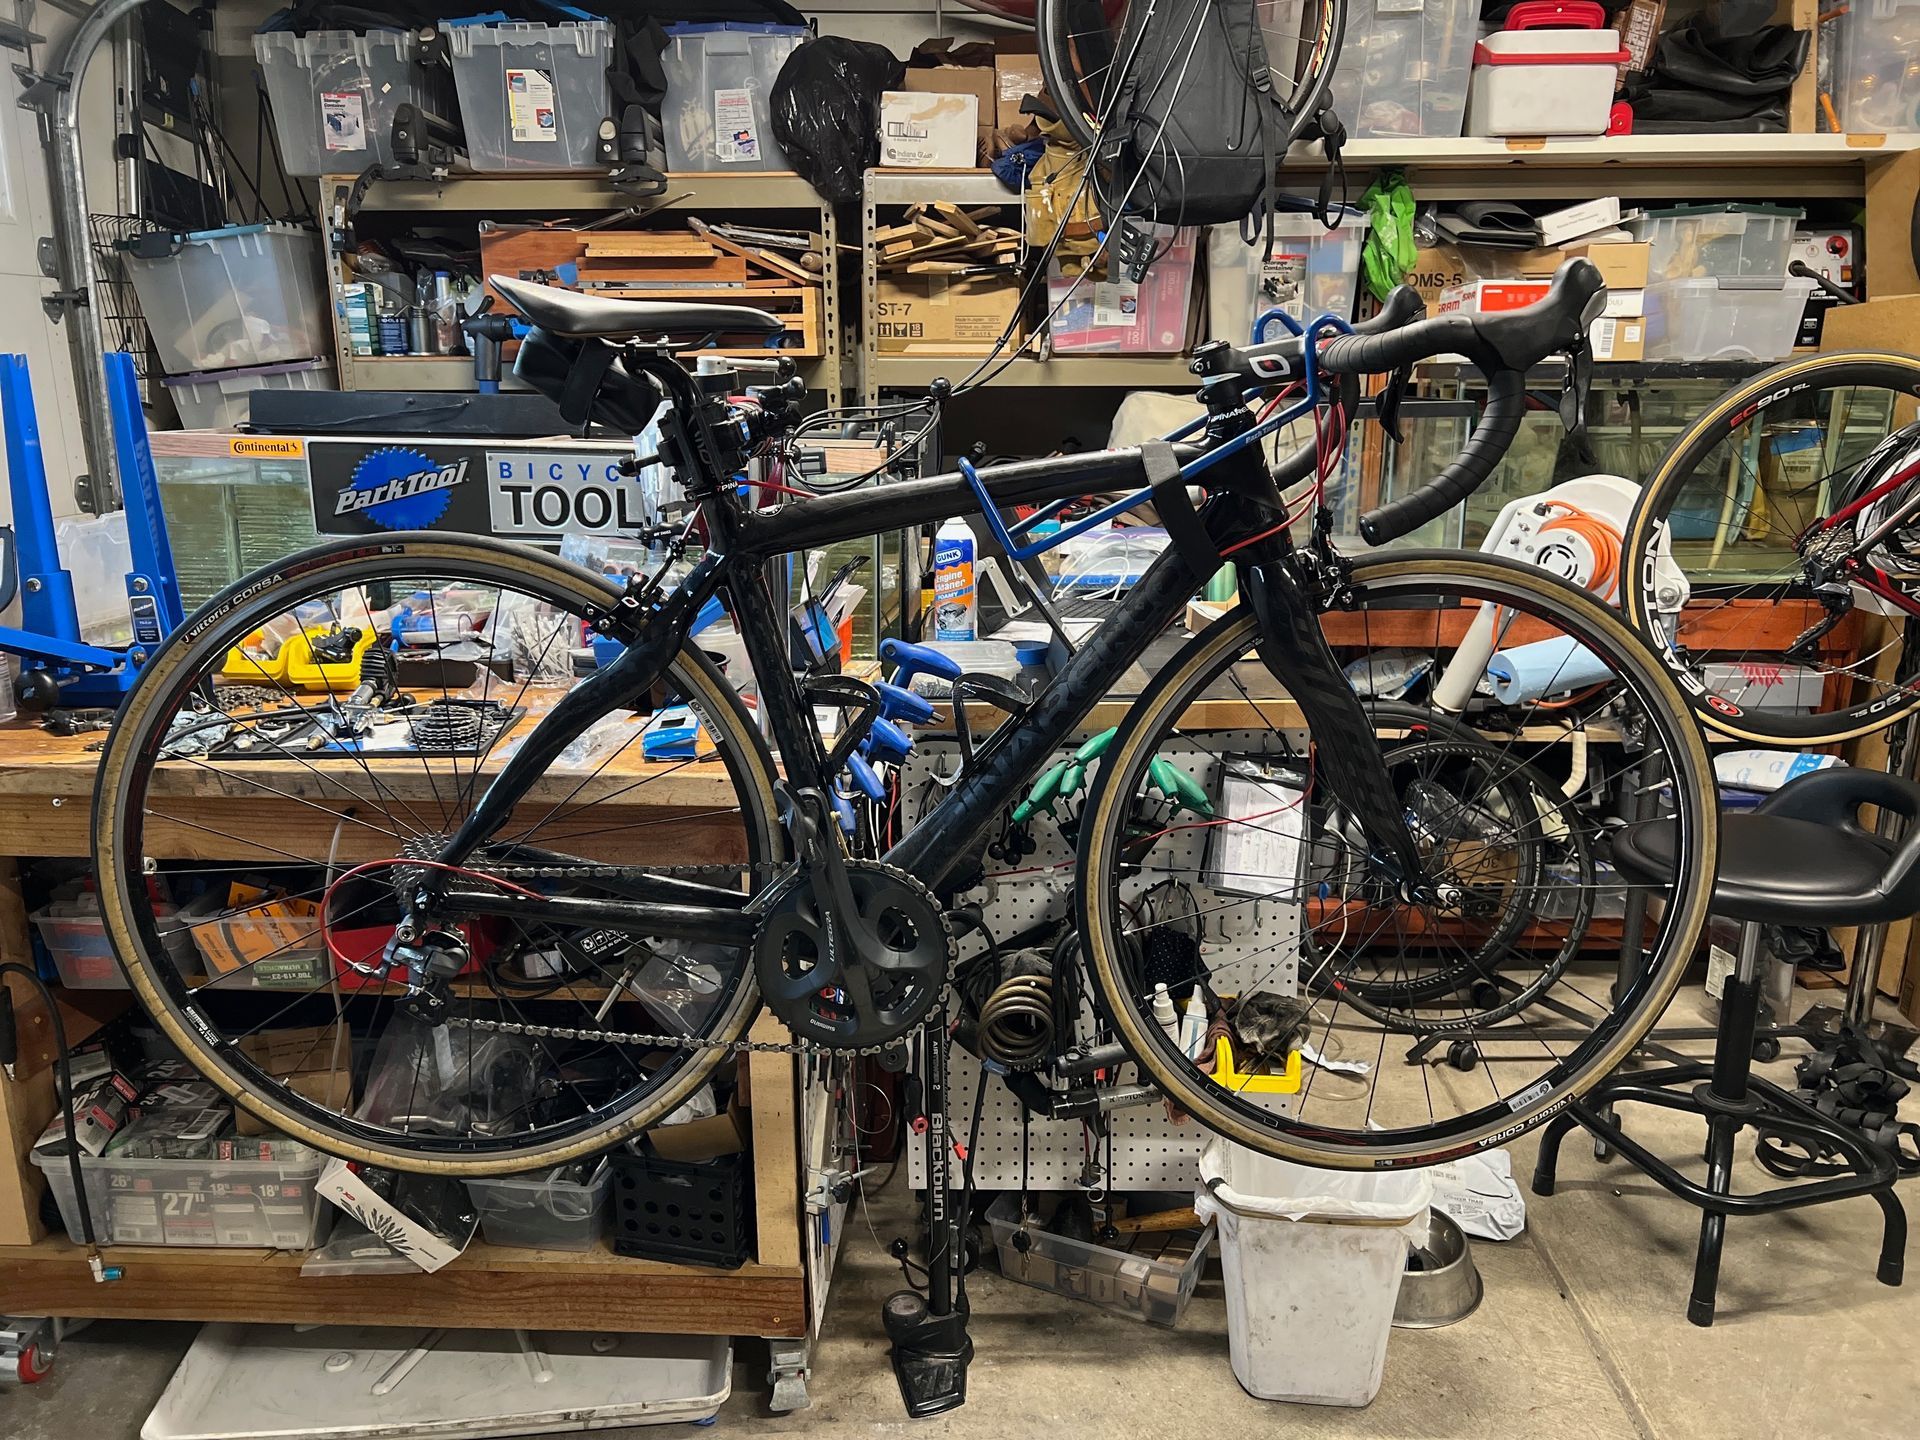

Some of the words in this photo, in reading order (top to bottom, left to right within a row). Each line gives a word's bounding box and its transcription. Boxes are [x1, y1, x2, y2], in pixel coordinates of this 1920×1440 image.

[878, 303, 912, 316] ST-7
[1730, 387, 1791, 428] EC90
[1791, 382, 1811, 394] SL
[233, 441, 290, 453] Continental
[500, 462, 641, 482] BICYC
[936, 550, 960, 563] GUNK
[189, 604, 230, 640] Vittoria
[233, 573, 283, 606] CORSA
[1643, 516, 1706, 697] EASTON
[824, 911, 835, 962] ULTEGRA
[593, 945, 608, 955] MADE
[72, 1089, 100, 1113] 0"
[1528, 1100, 1568, 1126] Vittoria
[1478, 1124, 1525, 1147] CORSA
[931, 1112, 945, 1222] Blackburn
[258, 1184, 280, 1198] 18"
[161, 1192, 206, 1216] 27"
